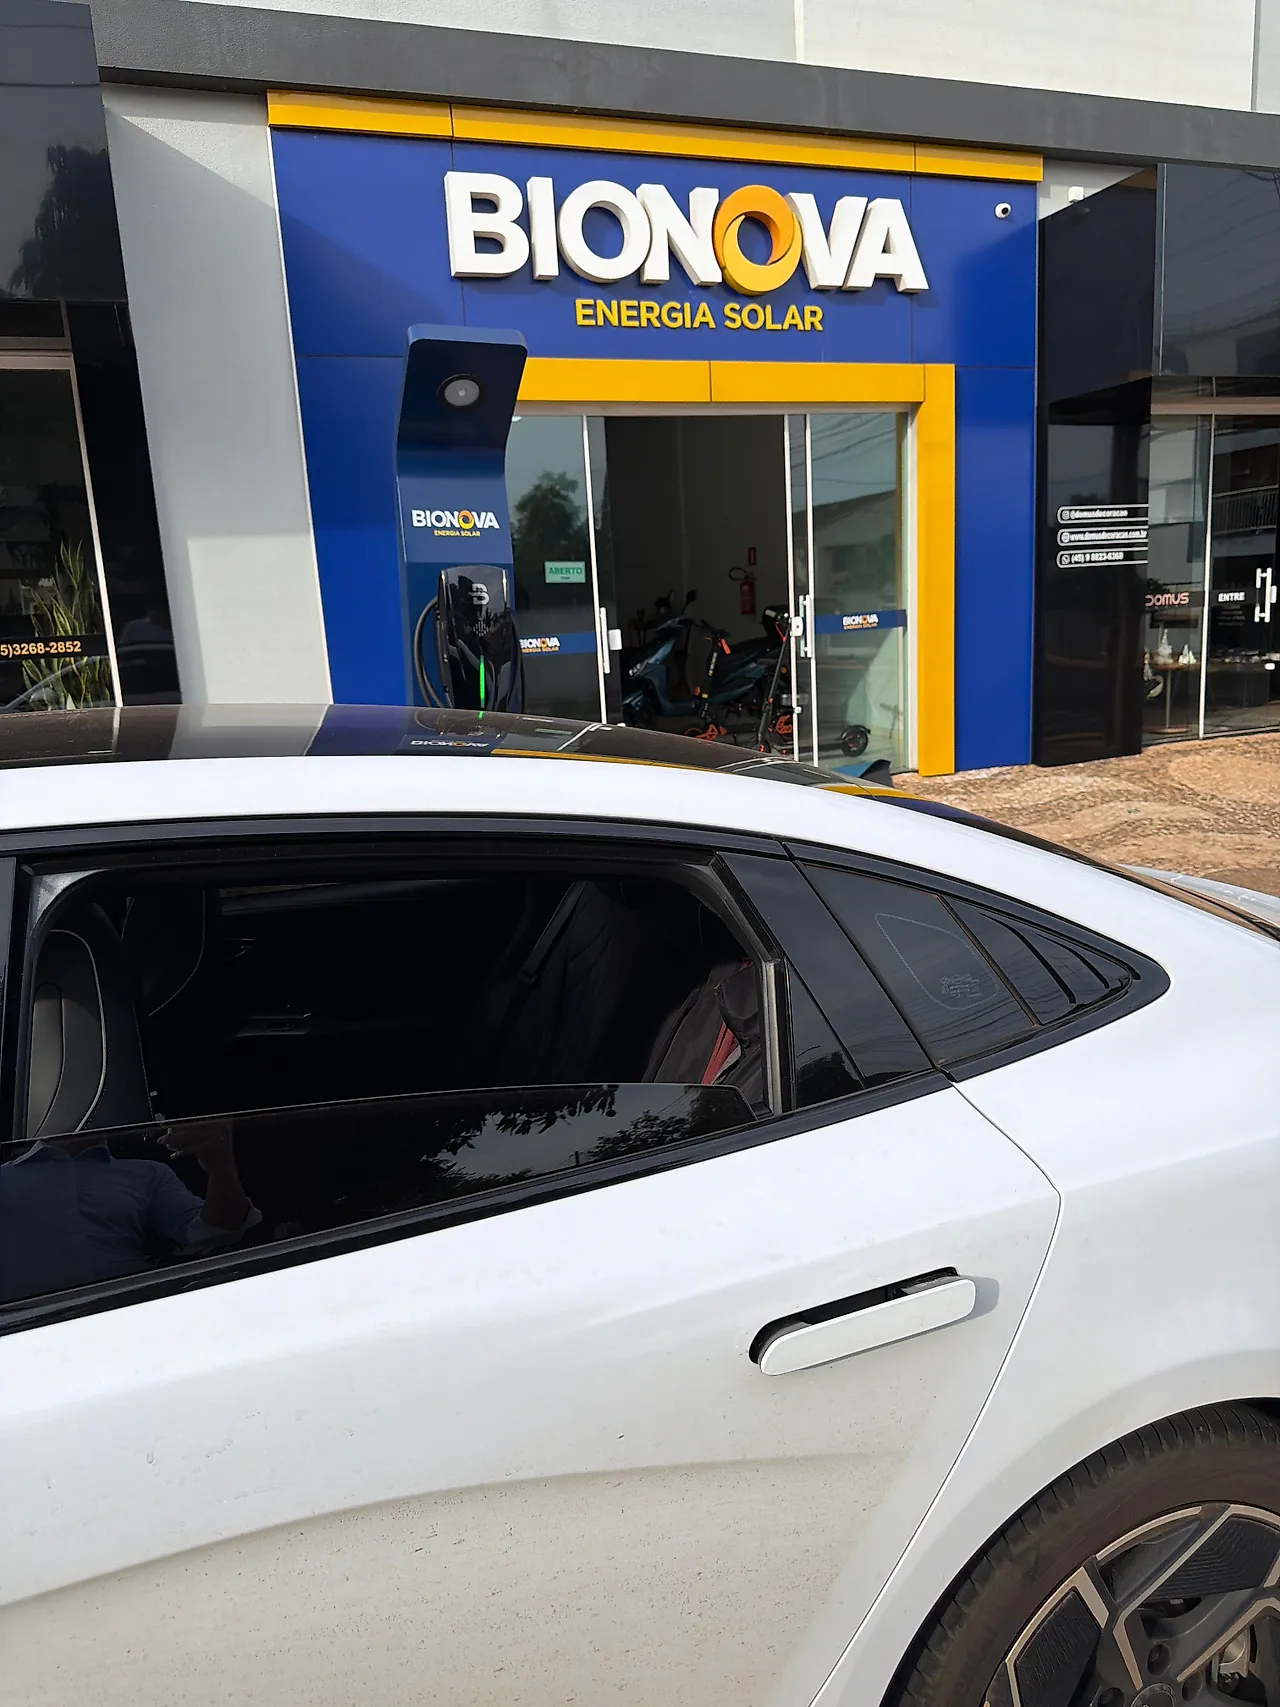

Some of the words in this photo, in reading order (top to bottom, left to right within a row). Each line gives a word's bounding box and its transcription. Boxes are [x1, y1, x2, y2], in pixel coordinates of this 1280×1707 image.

[444, 170, 929, 295] BIONOVA
[574, 298, 716, 330] ENERGIA
[723, 302, 824, 332] SOLAR
[411, 509, 500, 530] BIONOVA
[548, 567, 583, 575] ABERTO
[1218, 592, 1245, 602] ENTRE
[843, 614, 879, 625] BIONOVA
[0, 641, 82, 658] 5)3268-2852
